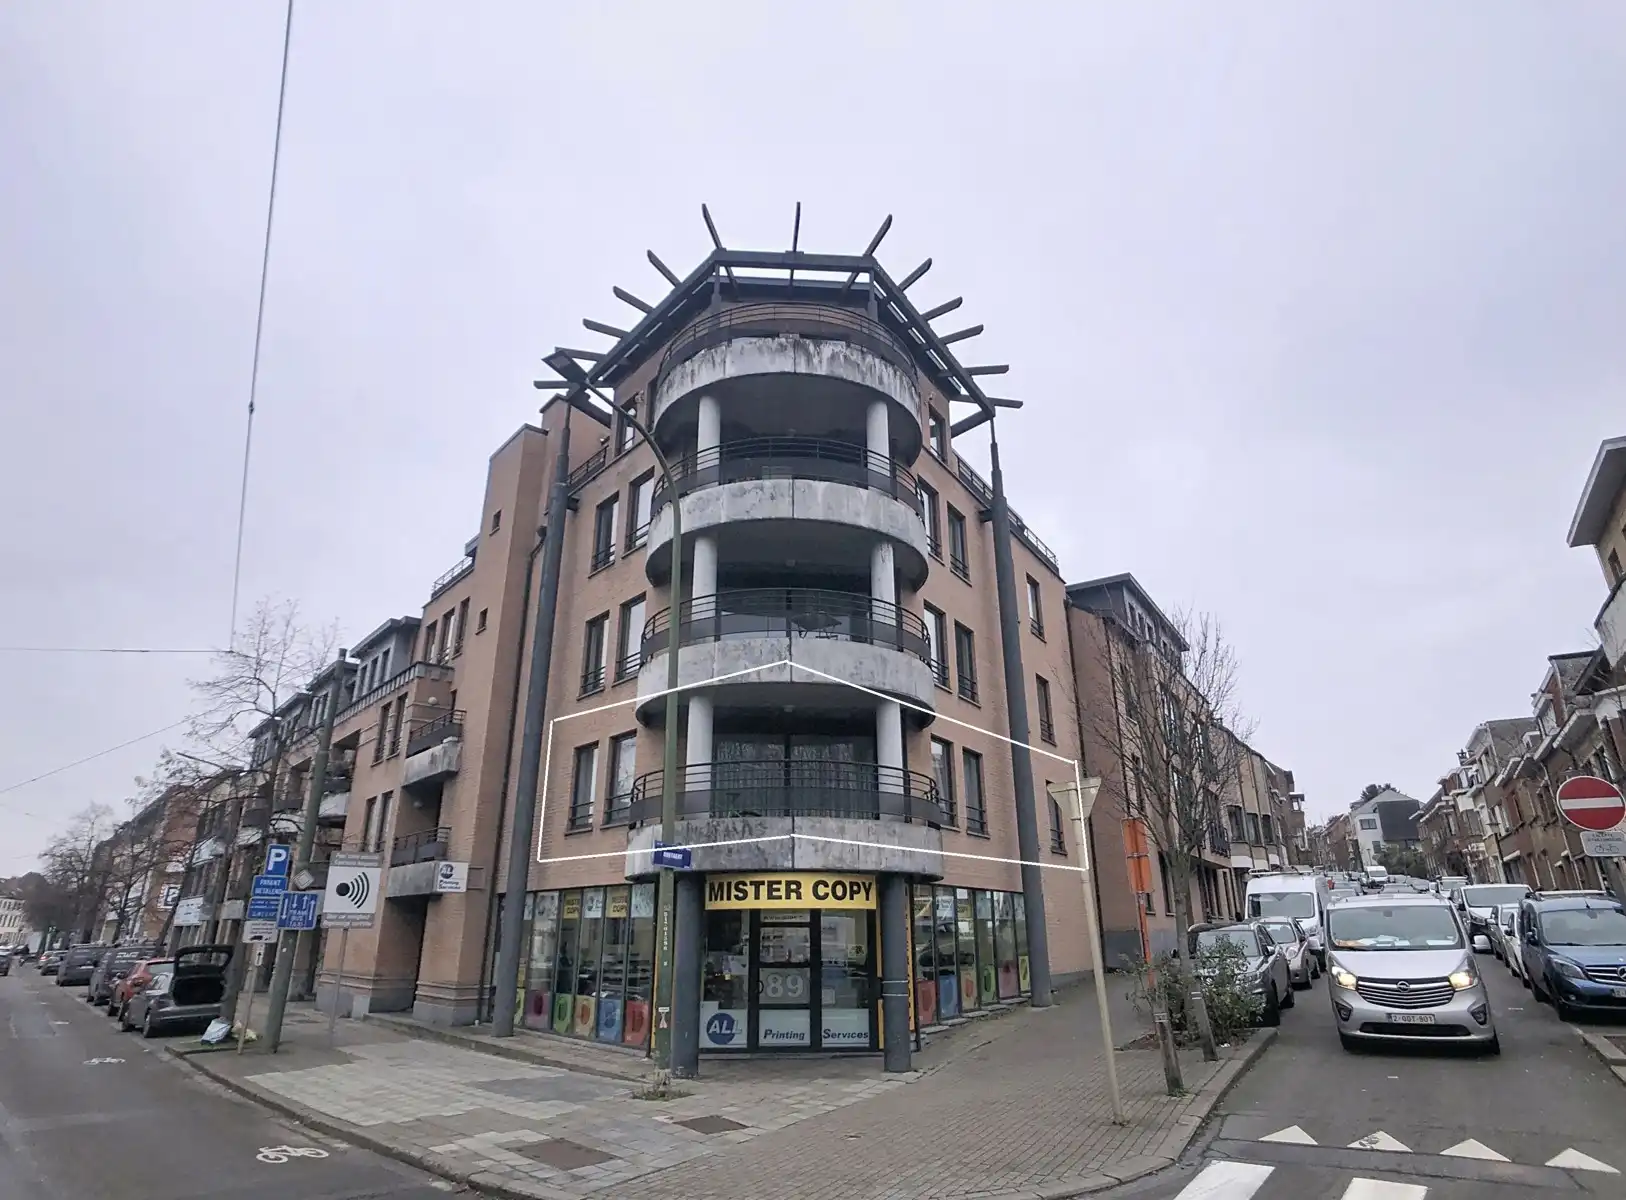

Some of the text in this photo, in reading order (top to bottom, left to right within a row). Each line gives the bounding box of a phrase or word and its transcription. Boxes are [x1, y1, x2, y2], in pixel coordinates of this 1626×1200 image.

[267, 848, 287, 871] P
[708, 880, 872, 902] MISTER COPY
[708, 1019, 743, 1035] ALL
[763, 1029, 805, 1041] Printing
[822, 1028, 869, 1039] Services
